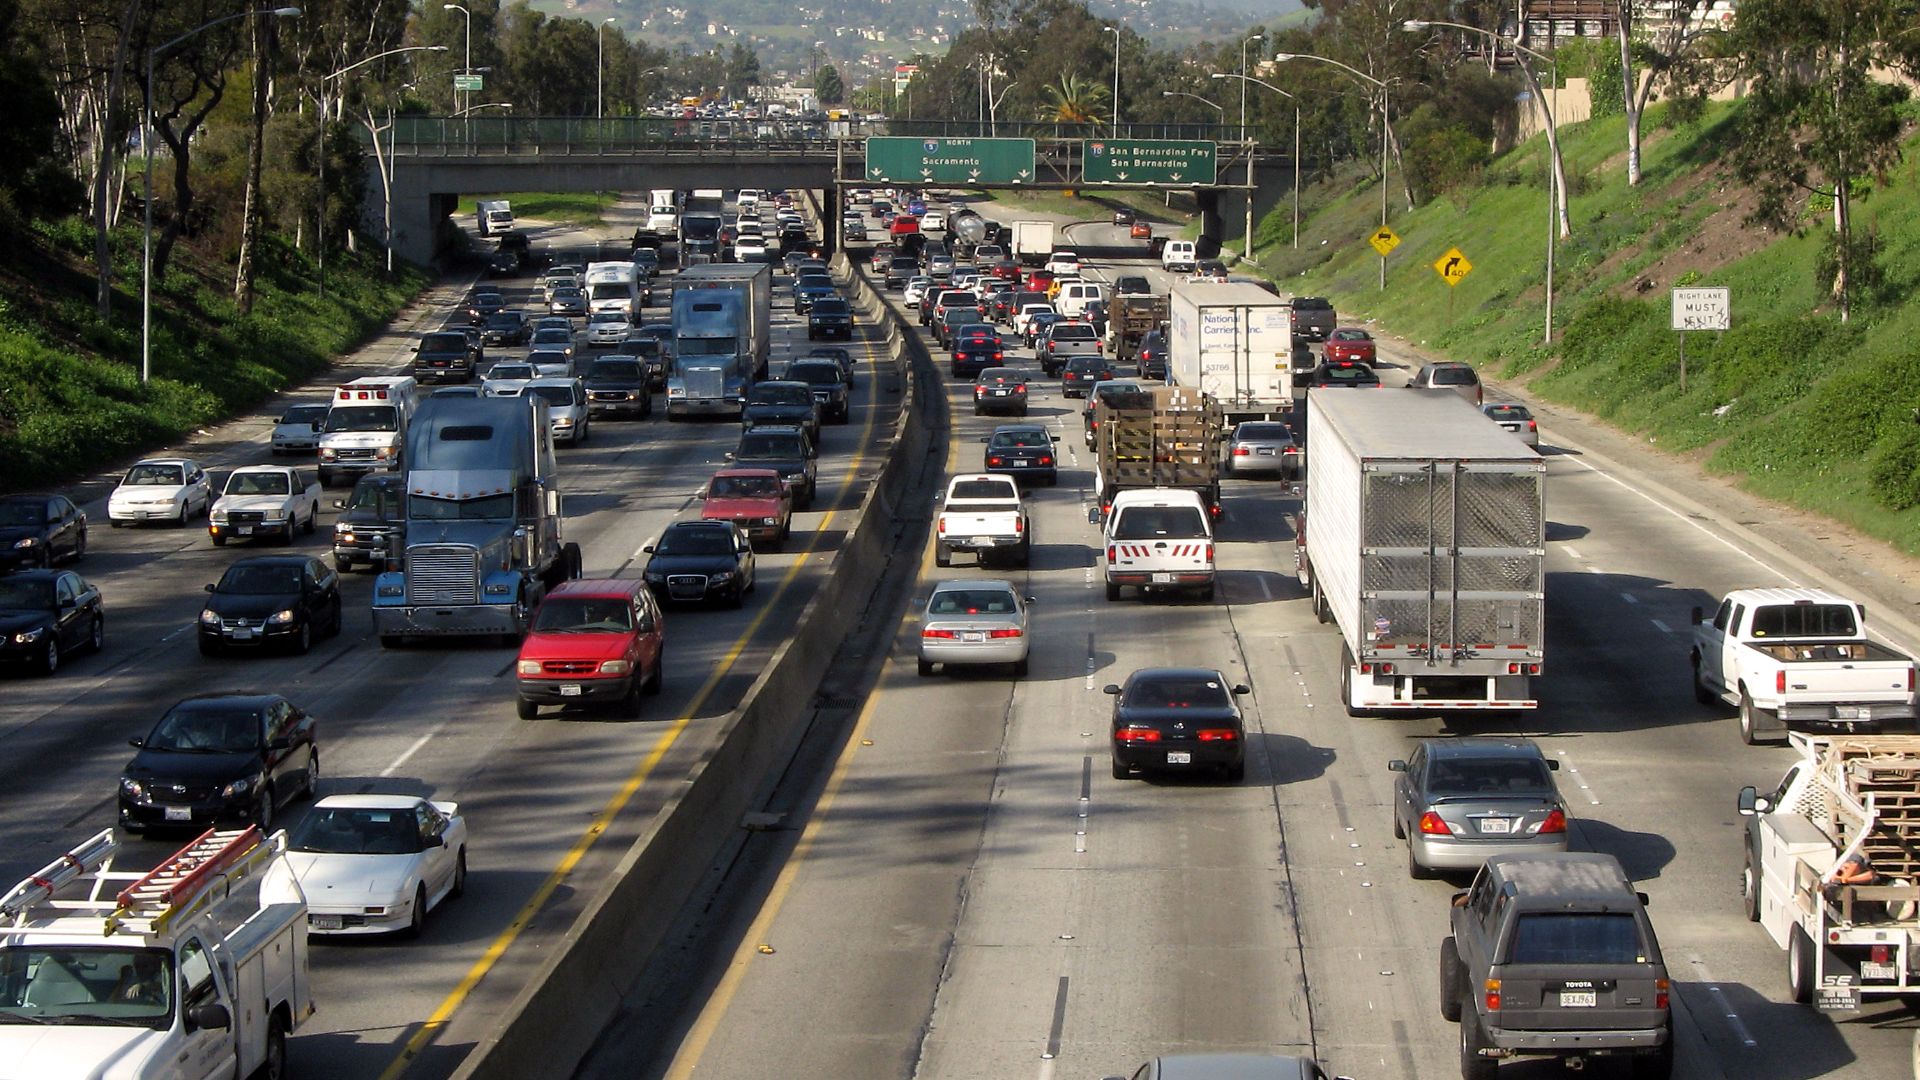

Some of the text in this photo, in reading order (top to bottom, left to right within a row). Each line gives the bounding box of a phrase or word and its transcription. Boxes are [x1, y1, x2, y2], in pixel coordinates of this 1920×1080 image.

[1109, 147, 1210, 158] San Bernardino Fwy
[922, 156, 980, 165] Sacramento
[1111, 159, 1188, 168] San Bernardino
[1685, 303, 1716, 312] MUST
[1204, 315, 1241, 323] National
[1822, 975, 1853, 986] SE
